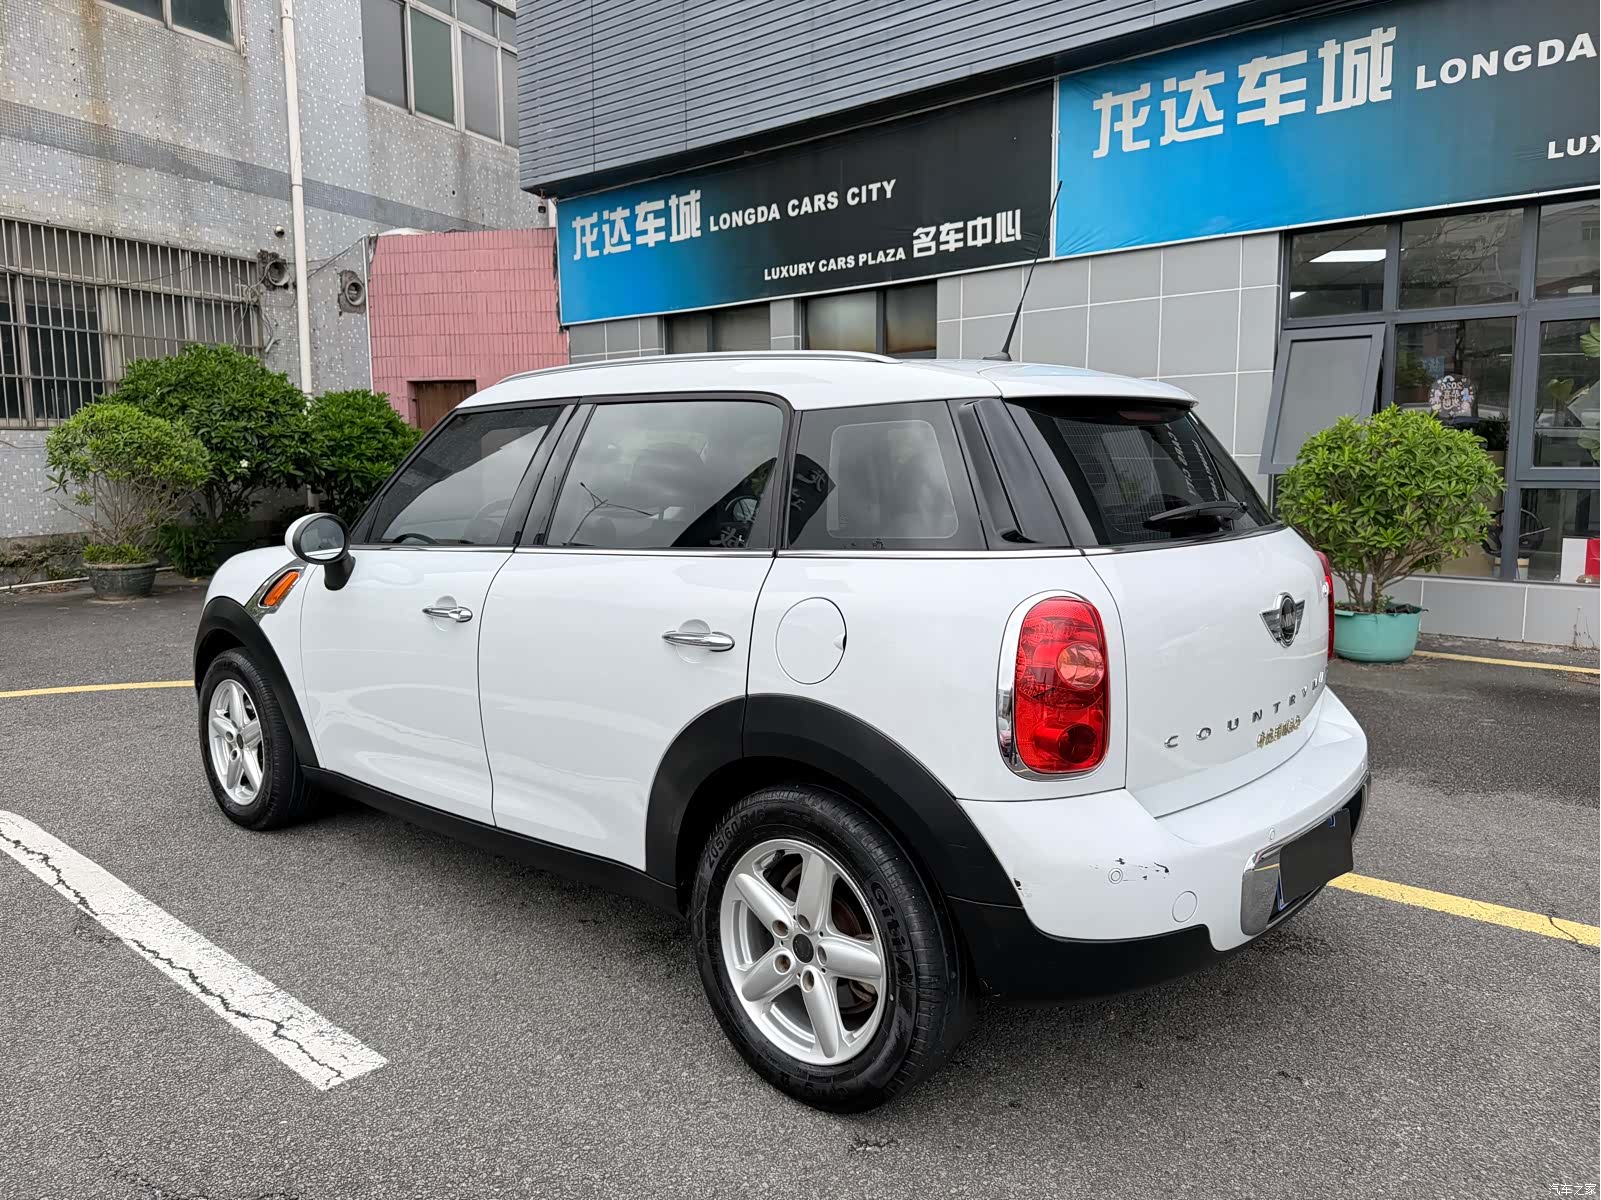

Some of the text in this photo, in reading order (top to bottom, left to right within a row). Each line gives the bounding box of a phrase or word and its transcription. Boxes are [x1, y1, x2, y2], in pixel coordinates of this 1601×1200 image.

[1416, 32, 1598, 90] LONGDA
[1093, 26, 1397, 159] 龙达车城
[572, 189, 702, 261] 龙达车城
[709, 179, 896, 232] LONGDA CARS CITY
[912, 208, 1022, 258] 名车中心
[764, 247, 906, 281] LUXURY CARS PLAZA
[1164, 664, 1329, 748] COUNTRY
